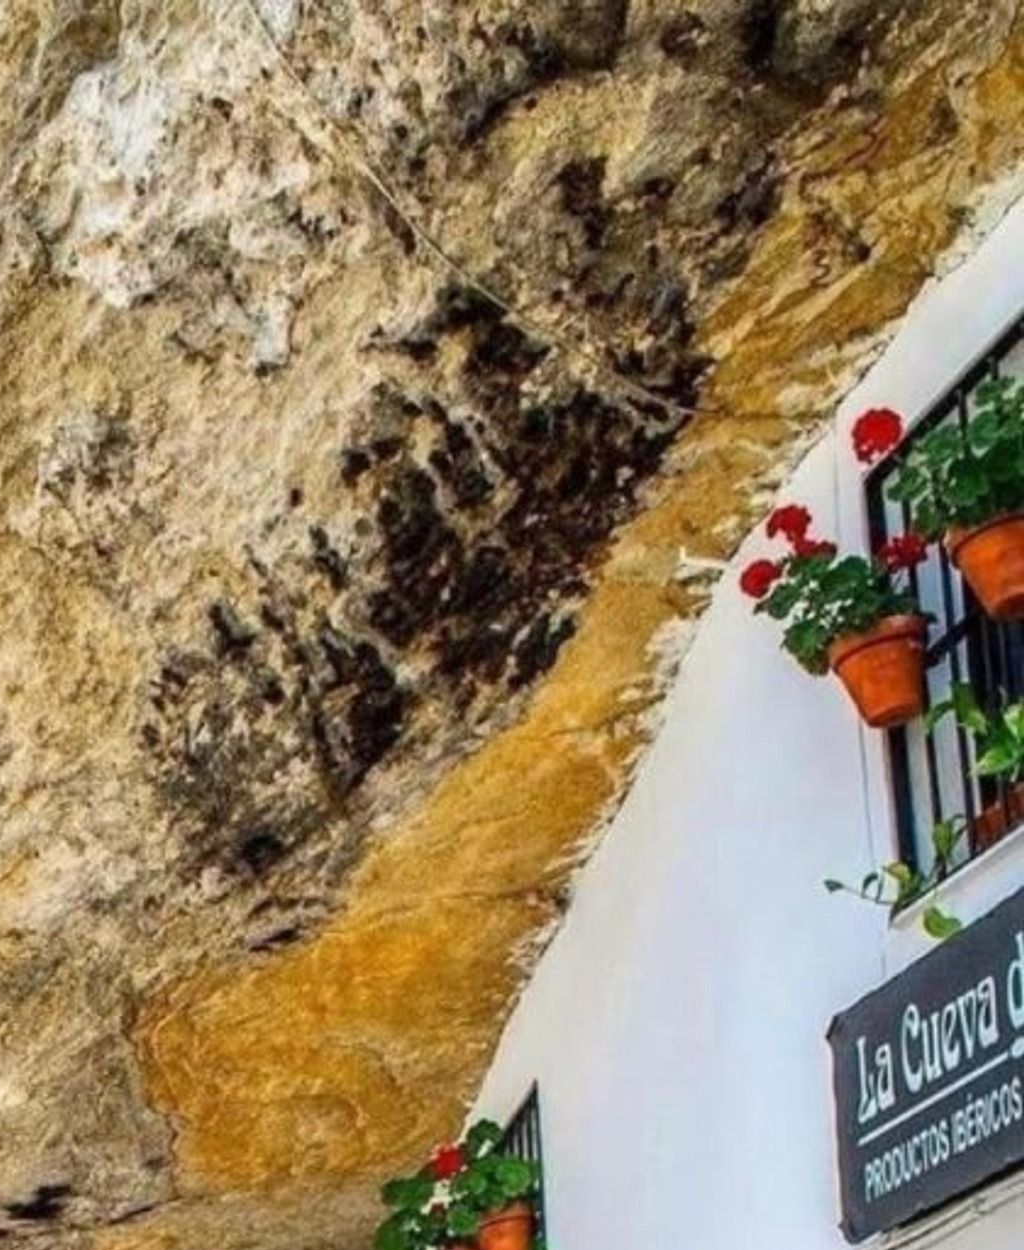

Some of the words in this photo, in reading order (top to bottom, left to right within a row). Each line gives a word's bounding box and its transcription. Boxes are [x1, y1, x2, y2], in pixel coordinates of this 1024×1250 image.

[856, 1036, 895, 1123] La
[901, 976, 999, 1093] Cueva
[864, 1118, 950, 1203] PRODUCTOS
[951, 1076, 1024, 1154] IBÉRICOS
